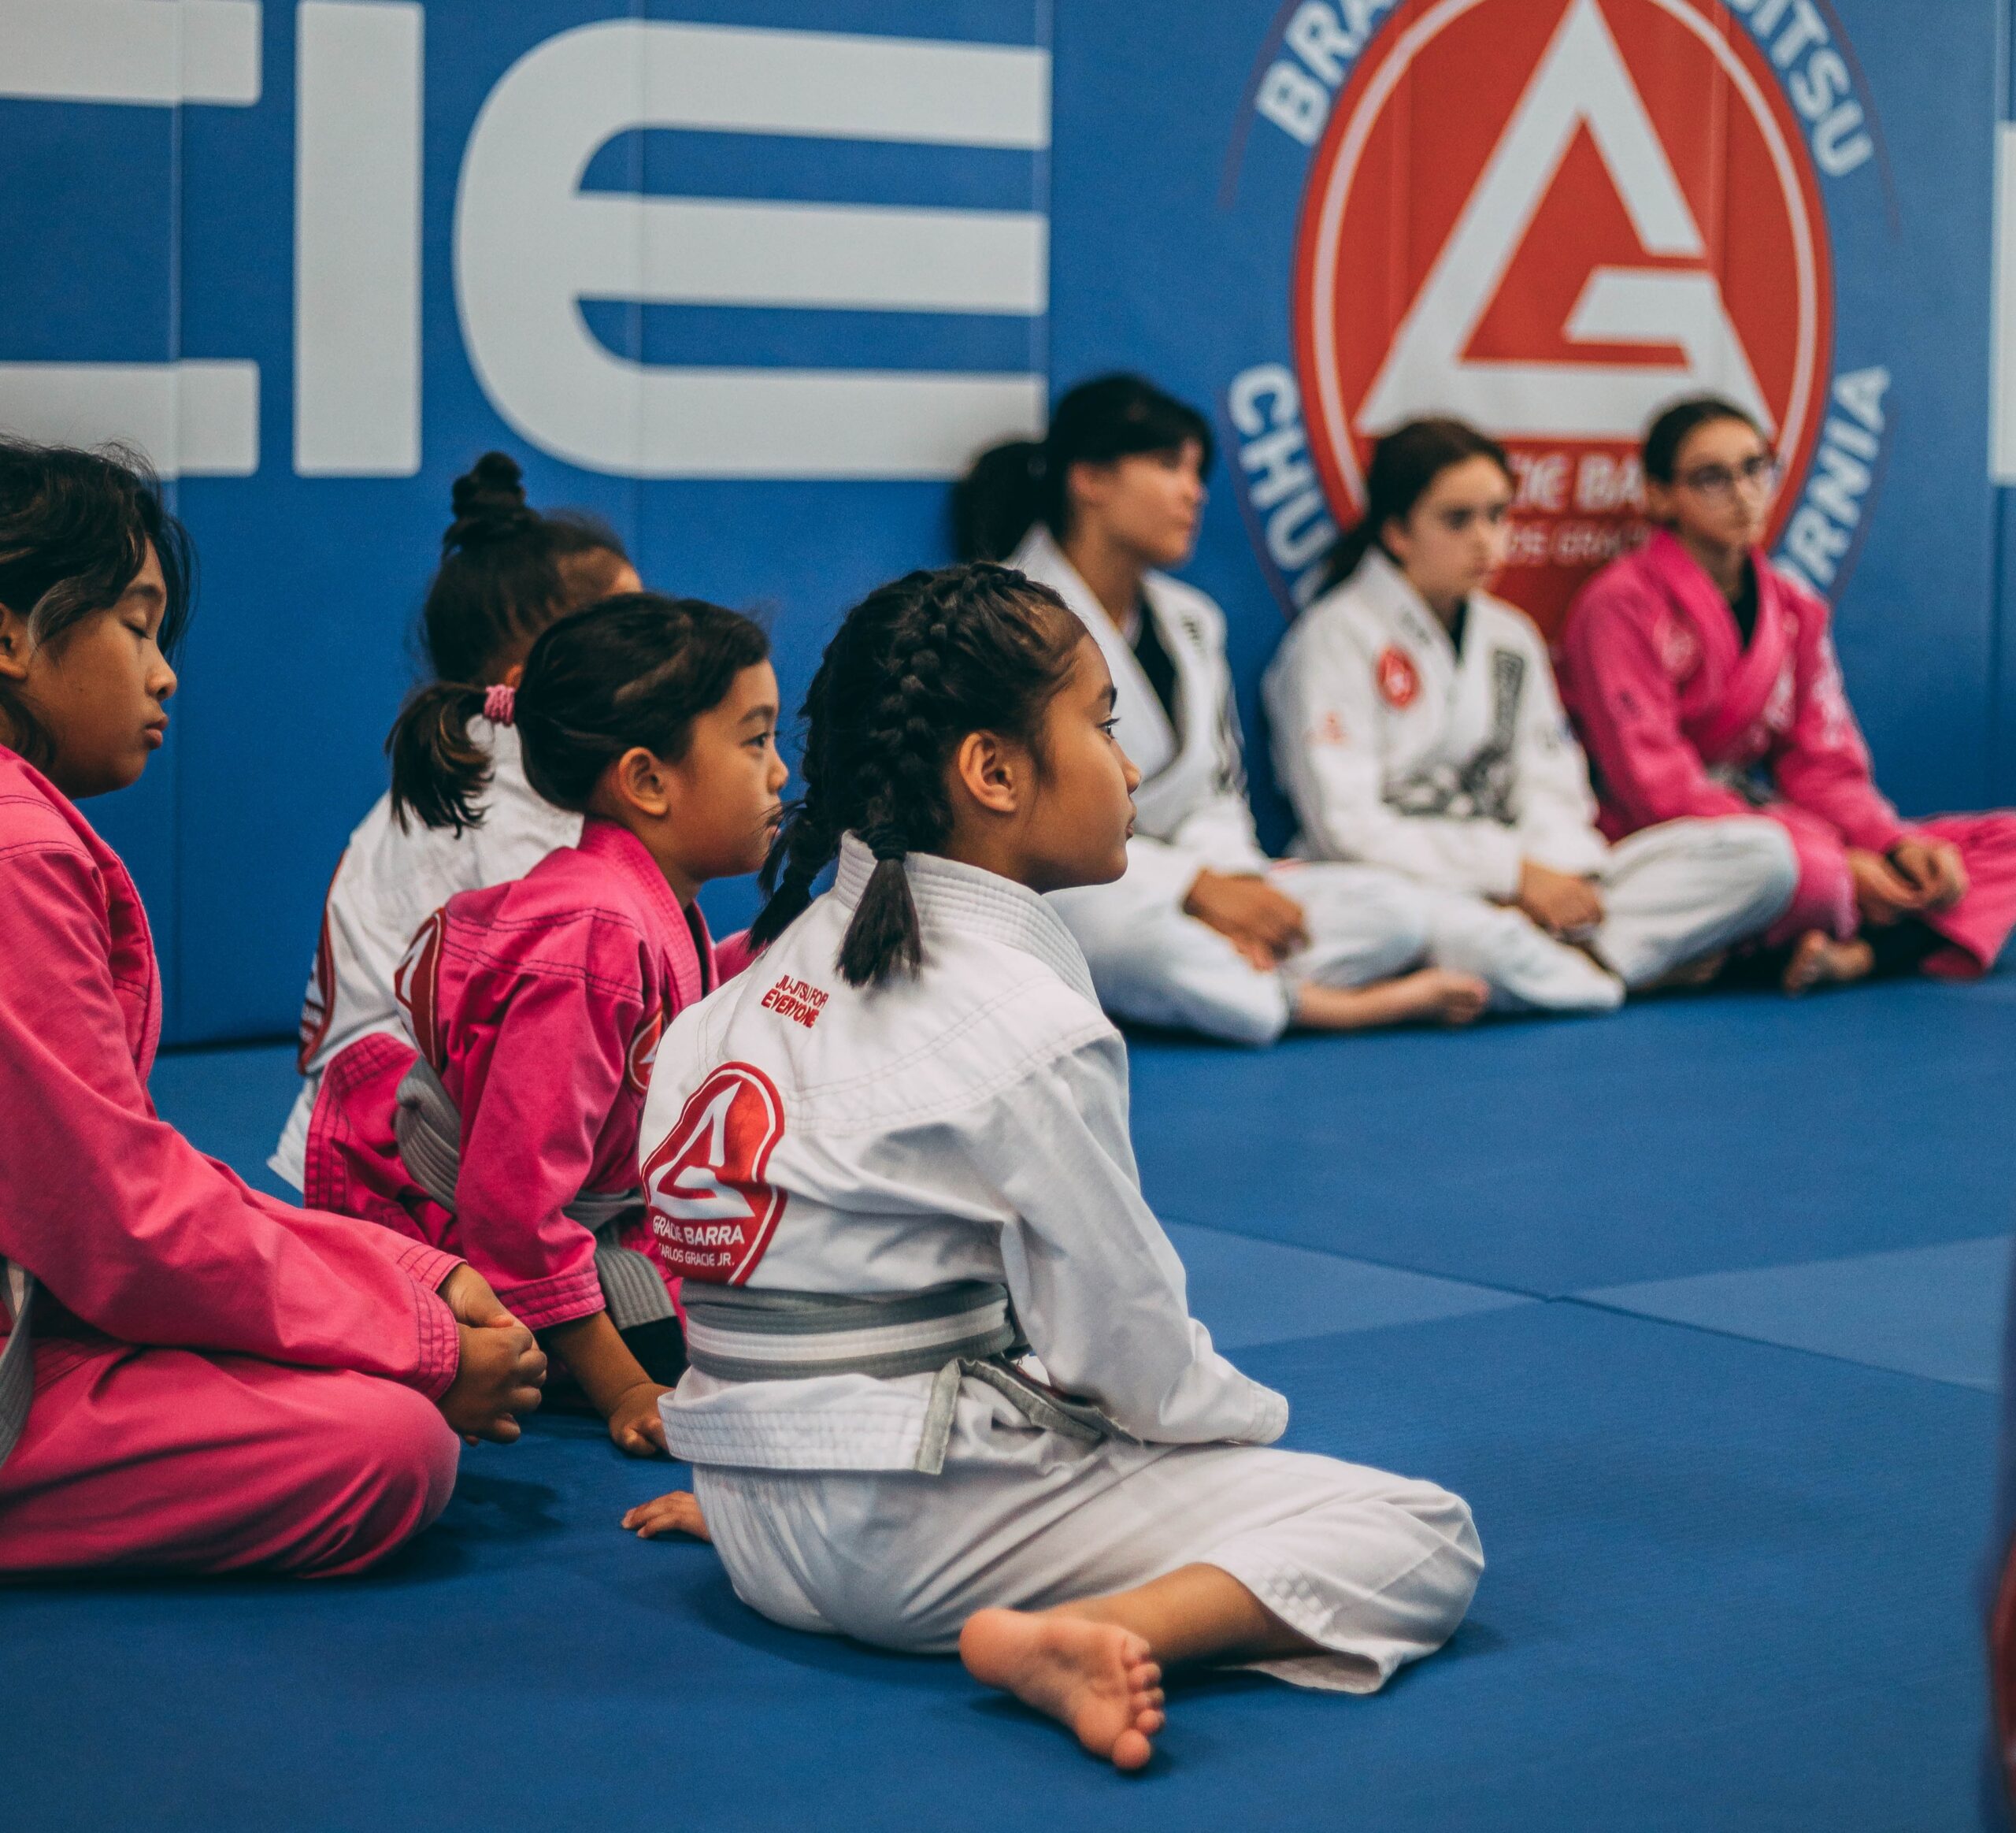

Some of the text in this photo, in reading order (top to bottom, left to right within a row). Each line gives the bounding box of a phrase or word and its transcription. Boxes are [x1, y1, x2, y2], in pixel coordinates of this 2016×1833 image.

[1729, 0, 1873, 176] ITSU
[1772, 365, 1891, 599] RNIA
[761, 989, 820, 1029] EVERYONE
[808, 988, 829, 1009] FOR
[653, 1215, 745, 1246] GRACIE BARRA
[658, 1243, 735, 1267] ARLOS GRACIE JR.
